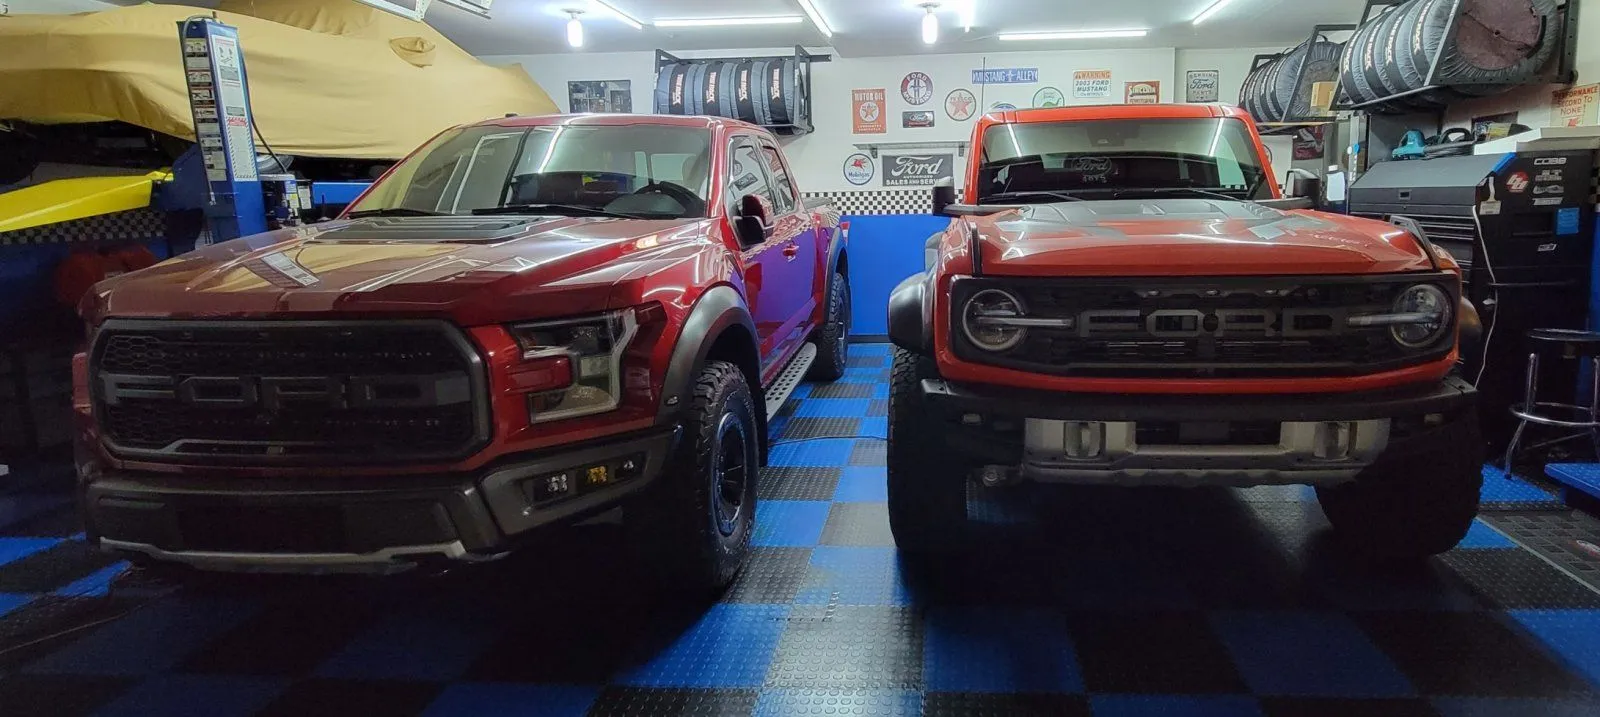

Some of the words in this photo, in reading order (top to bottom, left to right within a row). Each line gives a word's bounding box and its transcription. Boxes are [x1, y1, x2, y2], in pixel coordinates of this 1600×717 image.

[906, 73, 928, 81] FORD
[975, 71, 1006, 82] MUSTANG
[1016, 70, 1036, 81] ALLEY
[1190, 78, 1215, 89] Ford
[902, 91, 932, 105] MUSTANG
[891, 156, 944, 177] Ford
[1079, 308, 1342, 338] FORD
[100, 373, 438, 408] FORD
